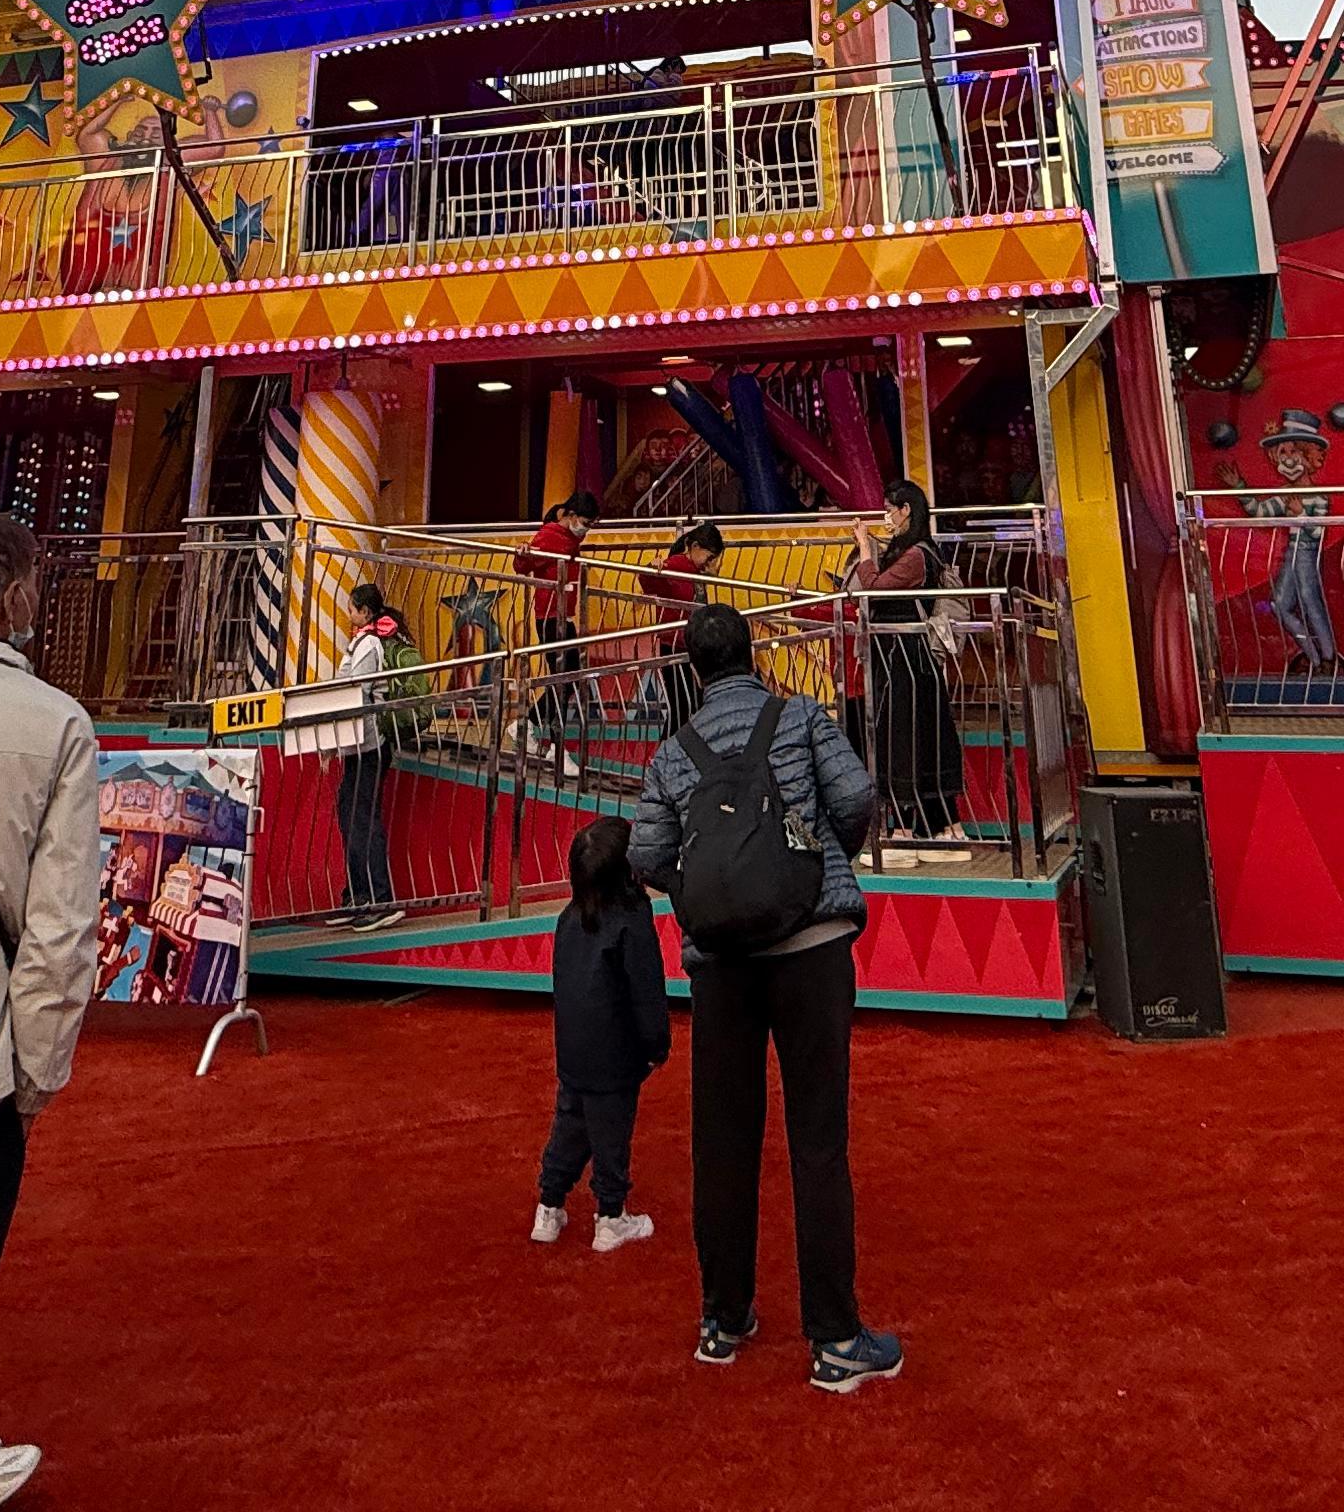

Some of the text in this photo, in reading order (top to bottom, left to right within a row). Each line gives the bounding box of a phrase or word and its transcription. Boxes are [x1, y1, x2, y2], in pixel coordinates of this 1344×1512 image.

[1096, 25, 1199, 57] ATTRACTIONS
[1102, 62, 1185, 98] SHOW
[1122, 106, 1185, 138] GAMES
[1107, 151, 1194, 172] WELCOME
[227, 699, 268, 728] EXIT
